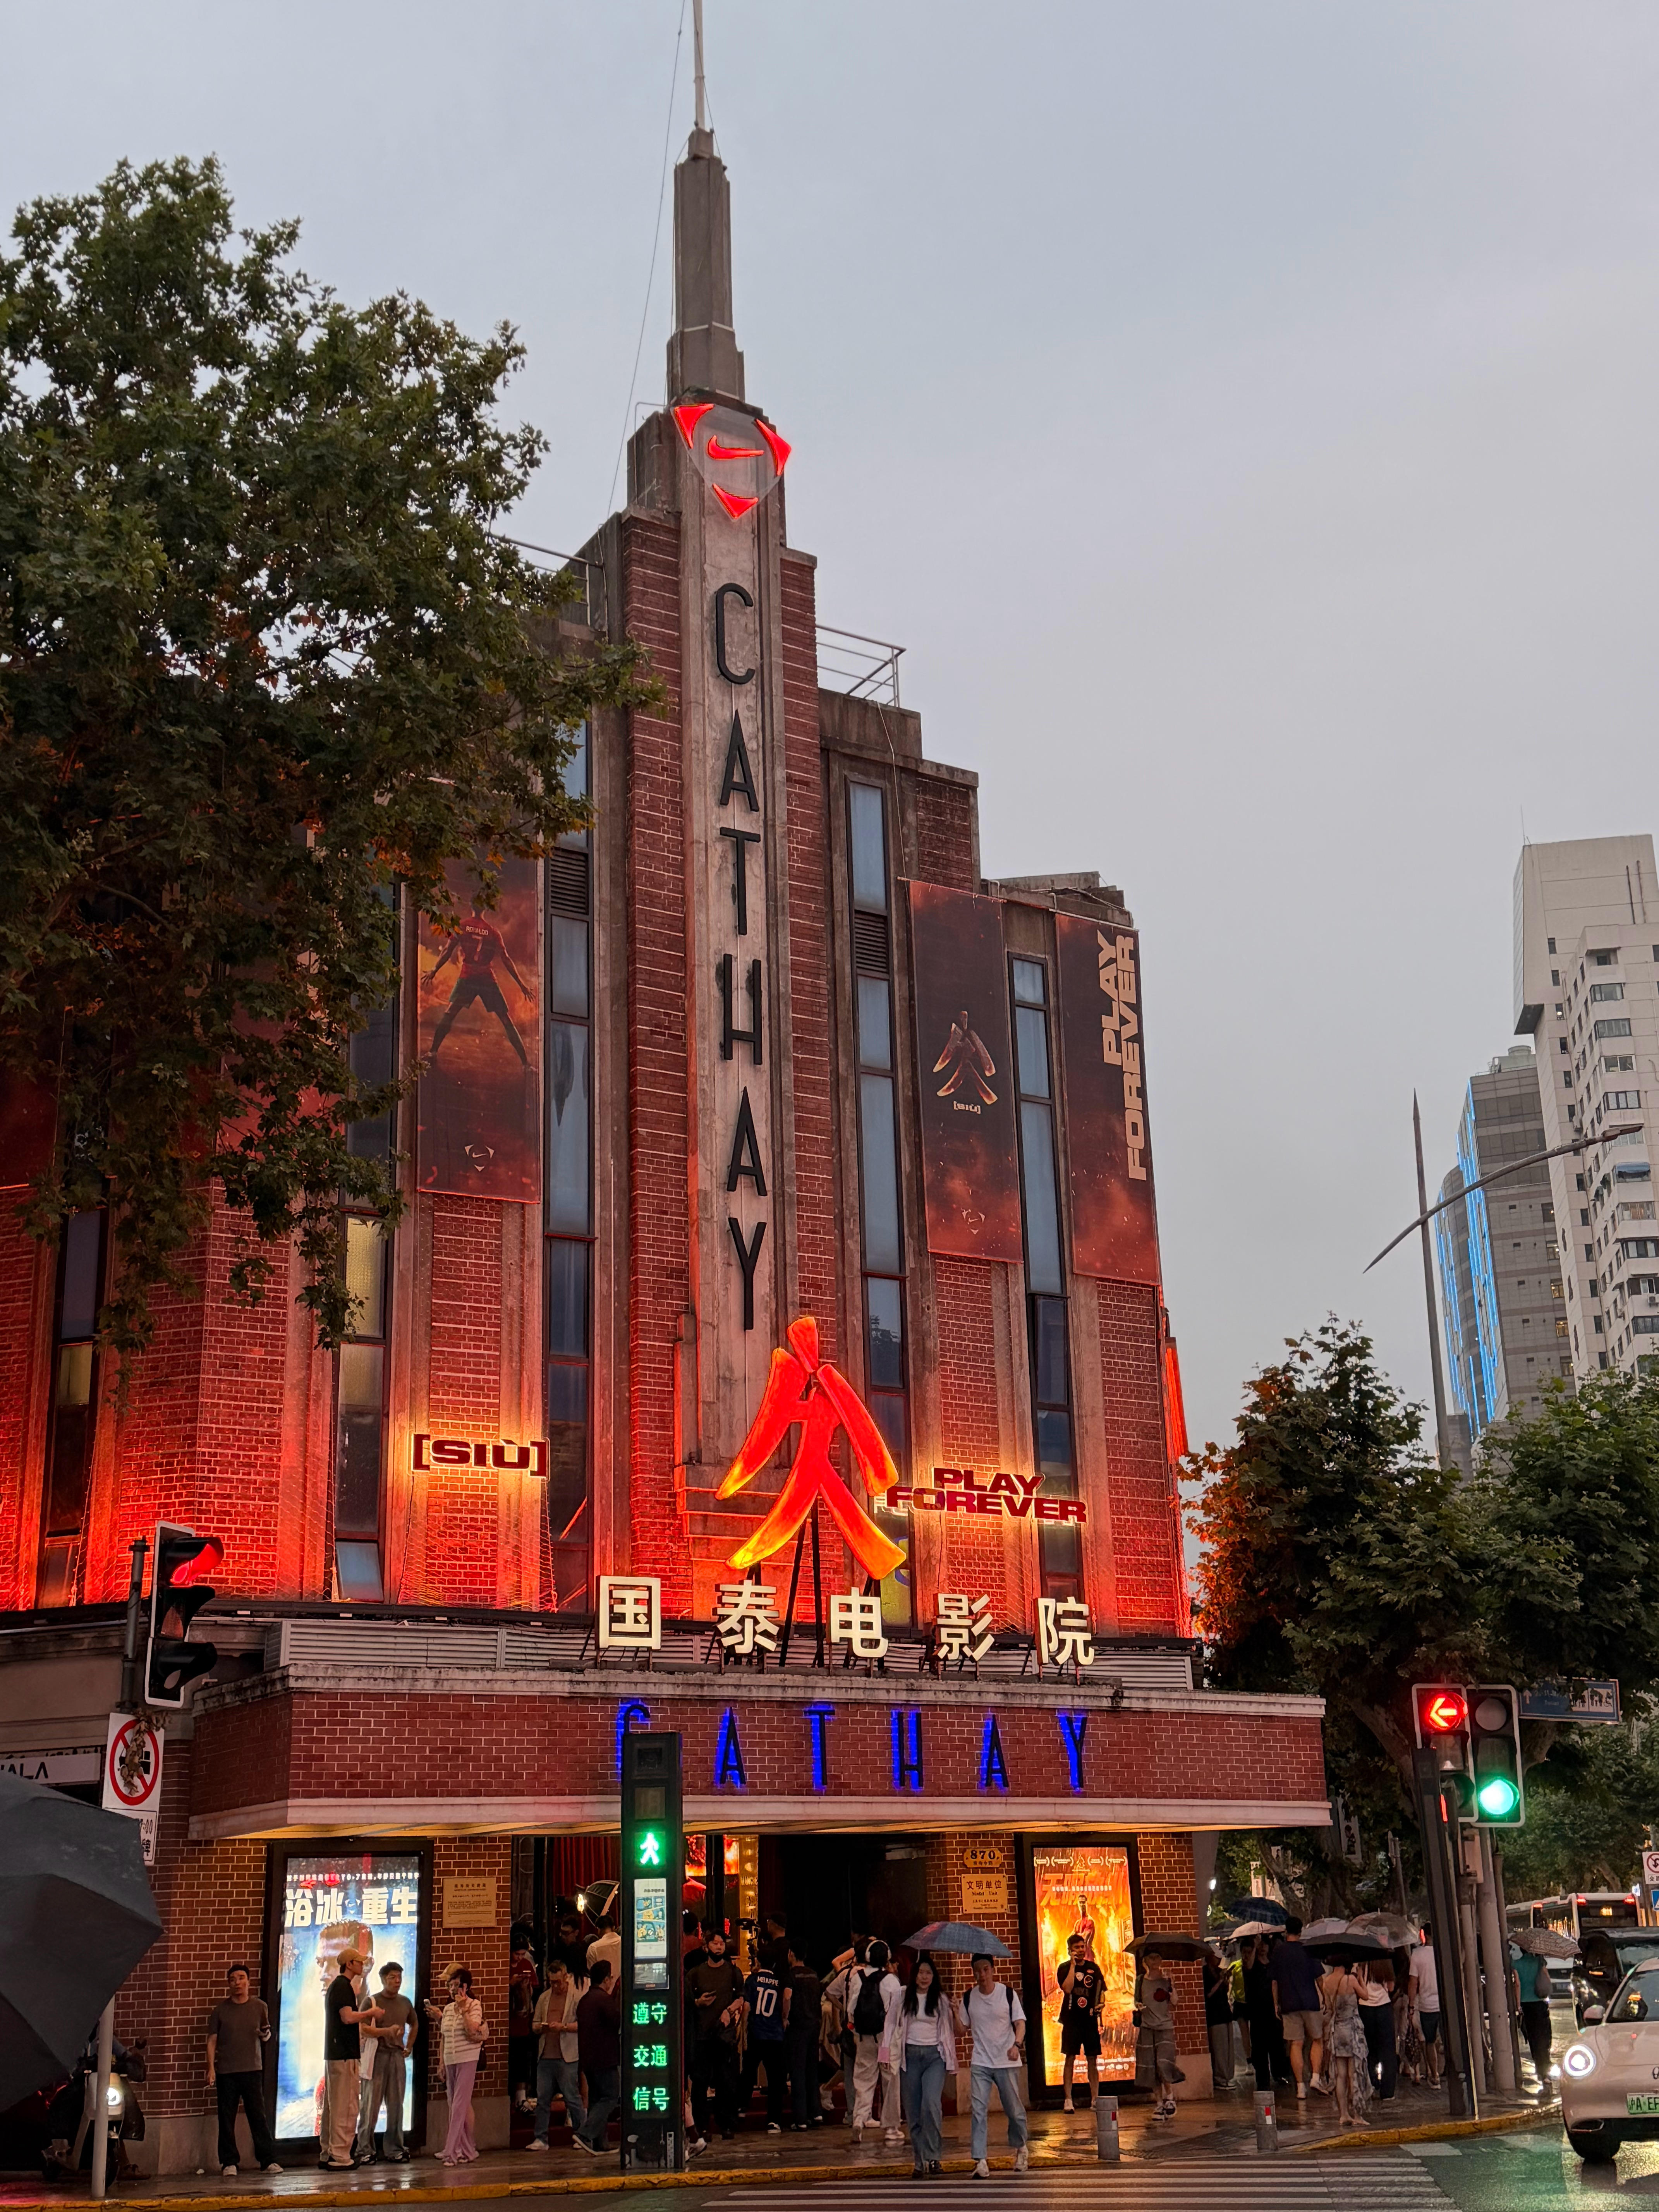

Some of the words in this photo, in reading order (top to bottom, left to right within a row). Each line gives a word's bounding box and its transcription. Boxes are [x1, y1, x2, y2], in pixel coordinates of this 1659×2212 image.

[472, 935, 483, 961] 7
[715, 582, 768, 1331] CATHAY
[1097, 929, 1122, 1065] PLAY
[1116, 935, 1147, 1181] FOREVER
[932, 1467, 1044, 1496] PLAY
[886, 1486, 1087, 1523] FOREVER
[598, 1575, 1095, 1666] 国泰电影院
[970, 1850, 996, 1859] 870
[967, 1880, 1002, 1890] 文明单位
[361, 1886, 418, 1924] 重生
[633, 2002, 667, 2024] 遵守
[756, 1987, 778, 2017] 10
[633, 2045, 667, 2067] 交通
[633, 2087, 670, 2111] 信号
